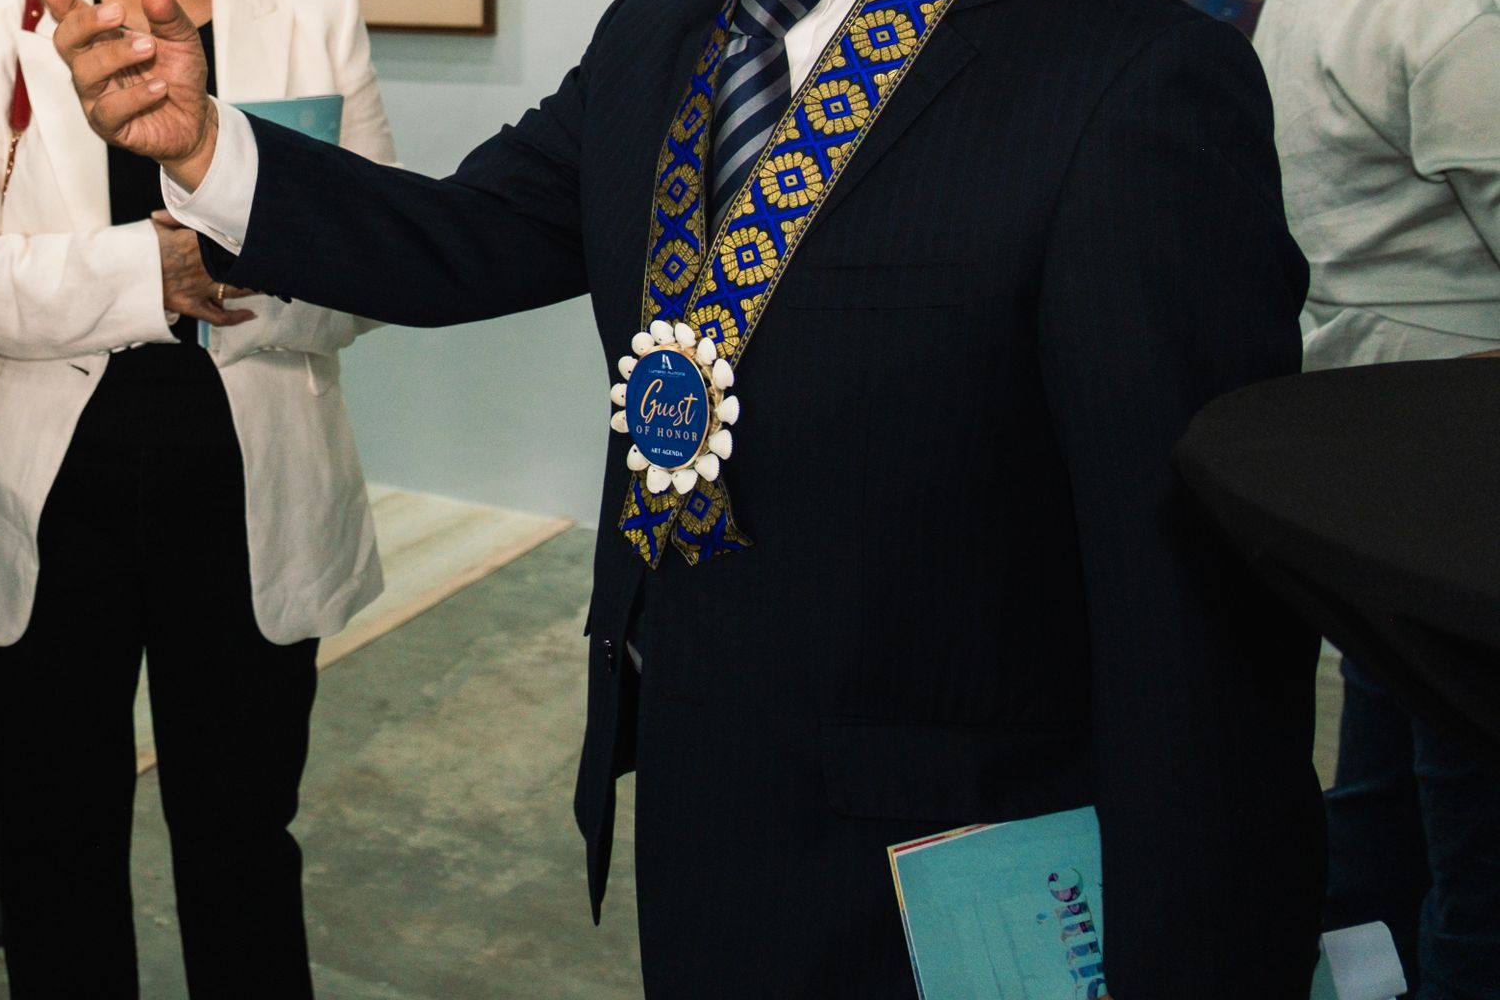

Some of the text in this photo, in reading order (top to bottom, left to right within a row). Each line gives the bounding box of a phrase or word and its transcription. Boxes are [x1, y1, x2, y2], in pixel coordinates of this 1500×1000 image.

[640, 378, 699, 426] Guest
[635, 424, 698, 442] OF HONOR
[662, 449, 684, 458] AGENDA
